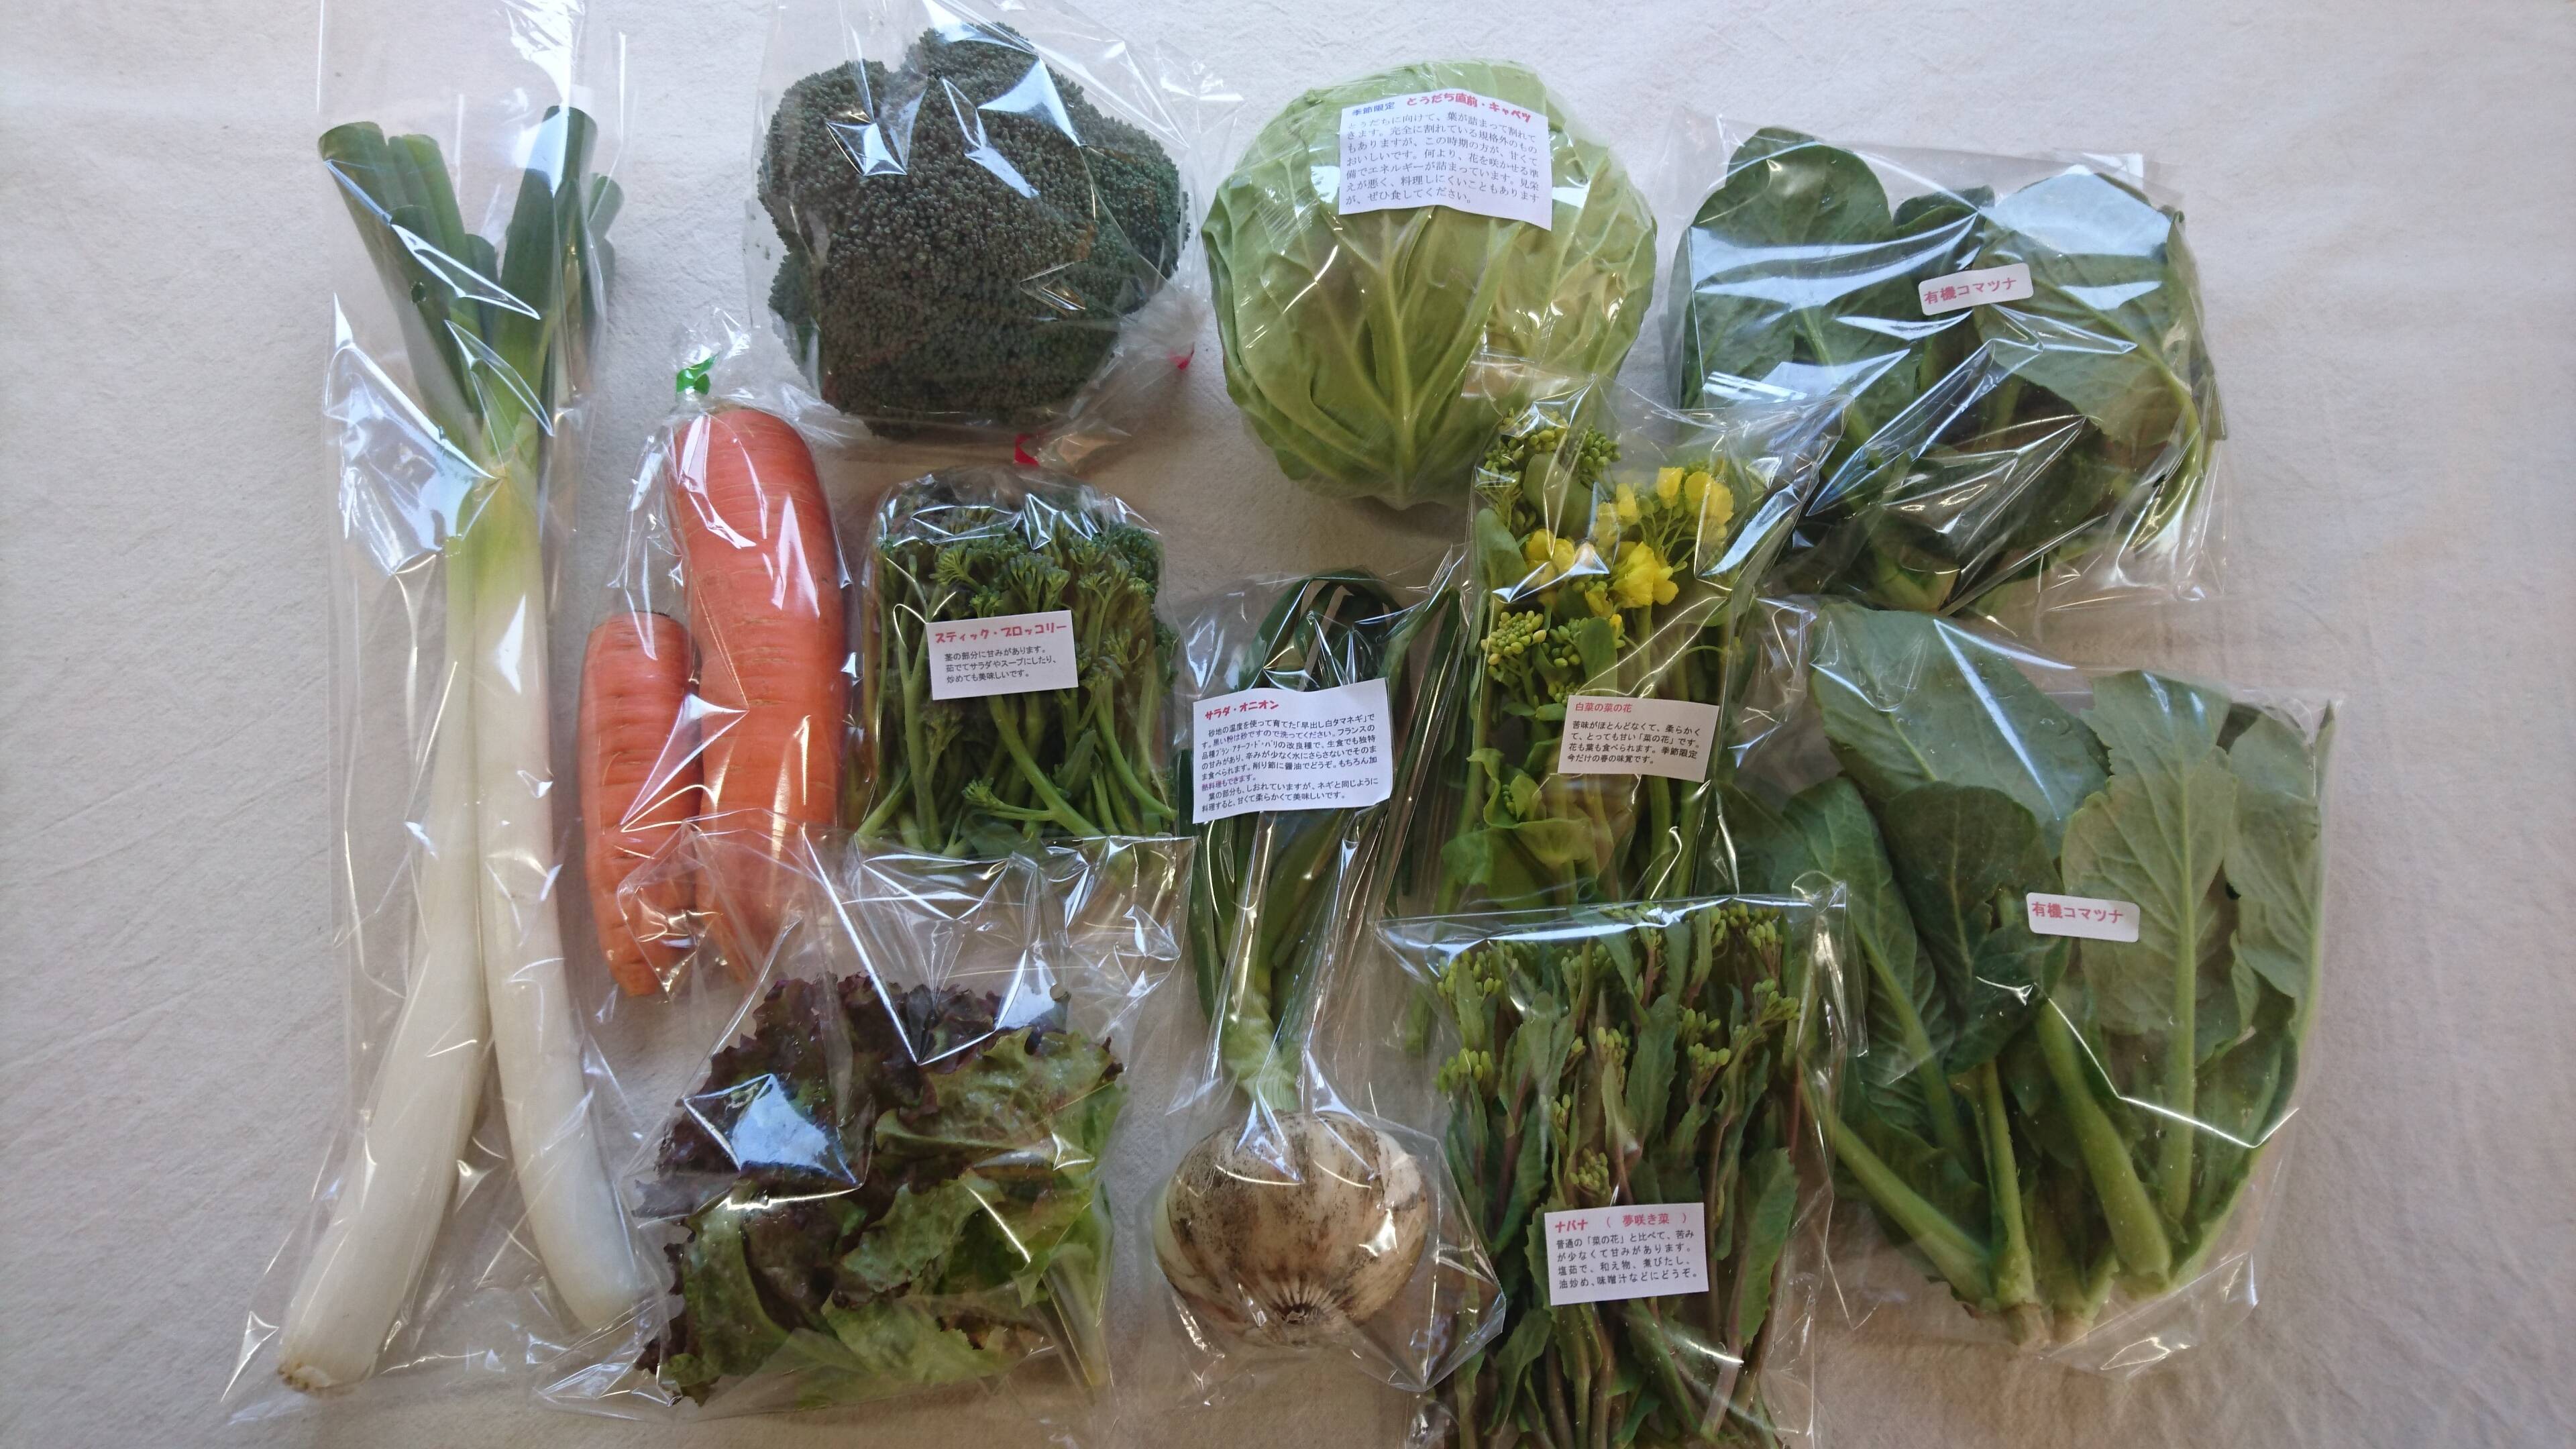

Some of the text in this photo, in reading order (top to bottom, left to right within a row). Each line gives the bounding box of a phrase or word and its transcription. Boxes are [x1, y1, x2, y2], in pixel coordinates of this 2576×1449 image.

[1352, 101, 1395, 116] 季節限定
[1346, 187, 1470, 205] が、ぜひ食してください。
[1347, 174, 1539, 203] えが悪く、料理しにくいこともあります
[1924, 277, 2017, 305] 有機コマツナ
[934, 623, 1067, 643] スティック・ブロッコリー
[944, 645, 1046, 661] 茎の部分に甘みがあります。
[946, 655, 1057, 672] 茹でてサラダやスープにしたり、
[947, 669, 1029, 684] 炒めても美味しいです。
[1205, 700, 1279, 720] サラダ・オニオン
[1575, 702, 1632, 713] 白菜の菜の花
[1572, 720, 1701, 736] 苦味がほとんどなくて、柔らかく
[1567, 753, 1654, 764] 今だけの春の味覚です。
[2031, 901, 2124, 924] 有機コマツナ
[1554, 1218, 1589, 1233] ナバナ
[1556, 1229, 1695, 1249] 普通の「菜の花」と比べて、苦み
[1557, 1242, 1690, 1263] が少なくて甘みがあります。
[1558, 1267, 1697, 1289] 油炒め、味噌汁などにどうぞ。
